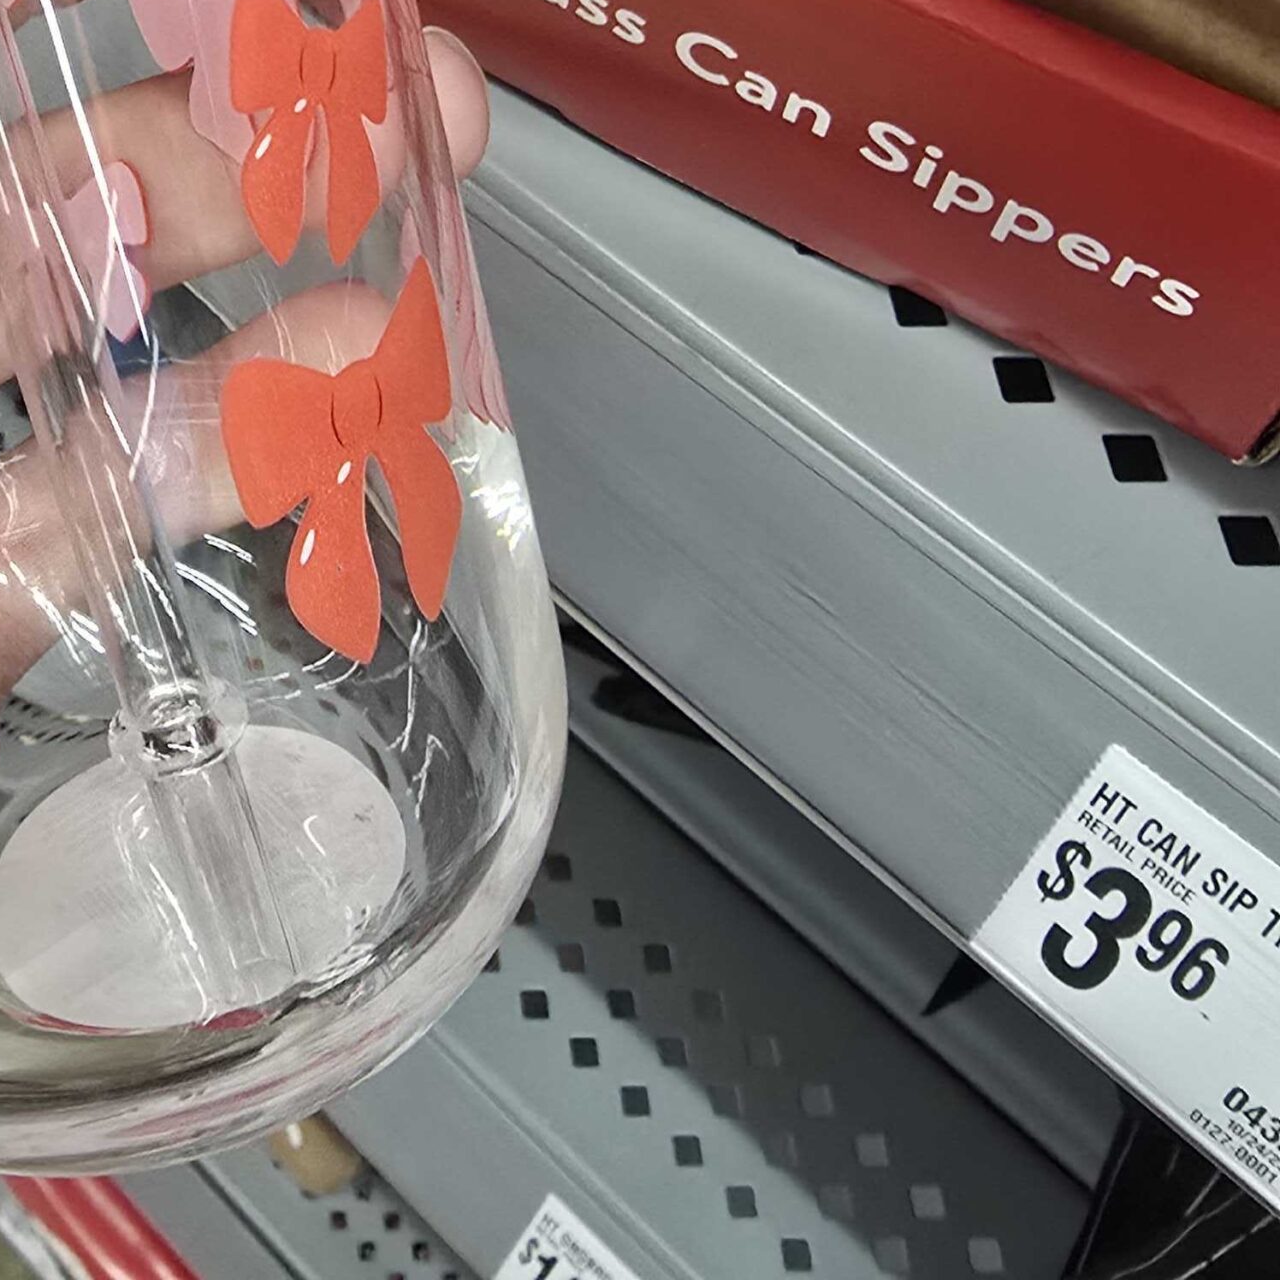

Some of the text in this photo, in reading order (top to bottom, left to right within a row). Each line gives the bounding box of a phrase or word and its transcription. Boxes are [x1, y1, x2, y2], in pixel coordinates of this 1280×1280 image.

[675, 32, 831, 138] Can
[859, 121, 1200, 316] Sippers
[1078, 810, 1196, 905] RETAIL PRICE
[1090, 782, 1280, 948] HT CAN SIP T
[1223, 1087, 1280, 1153] 043
